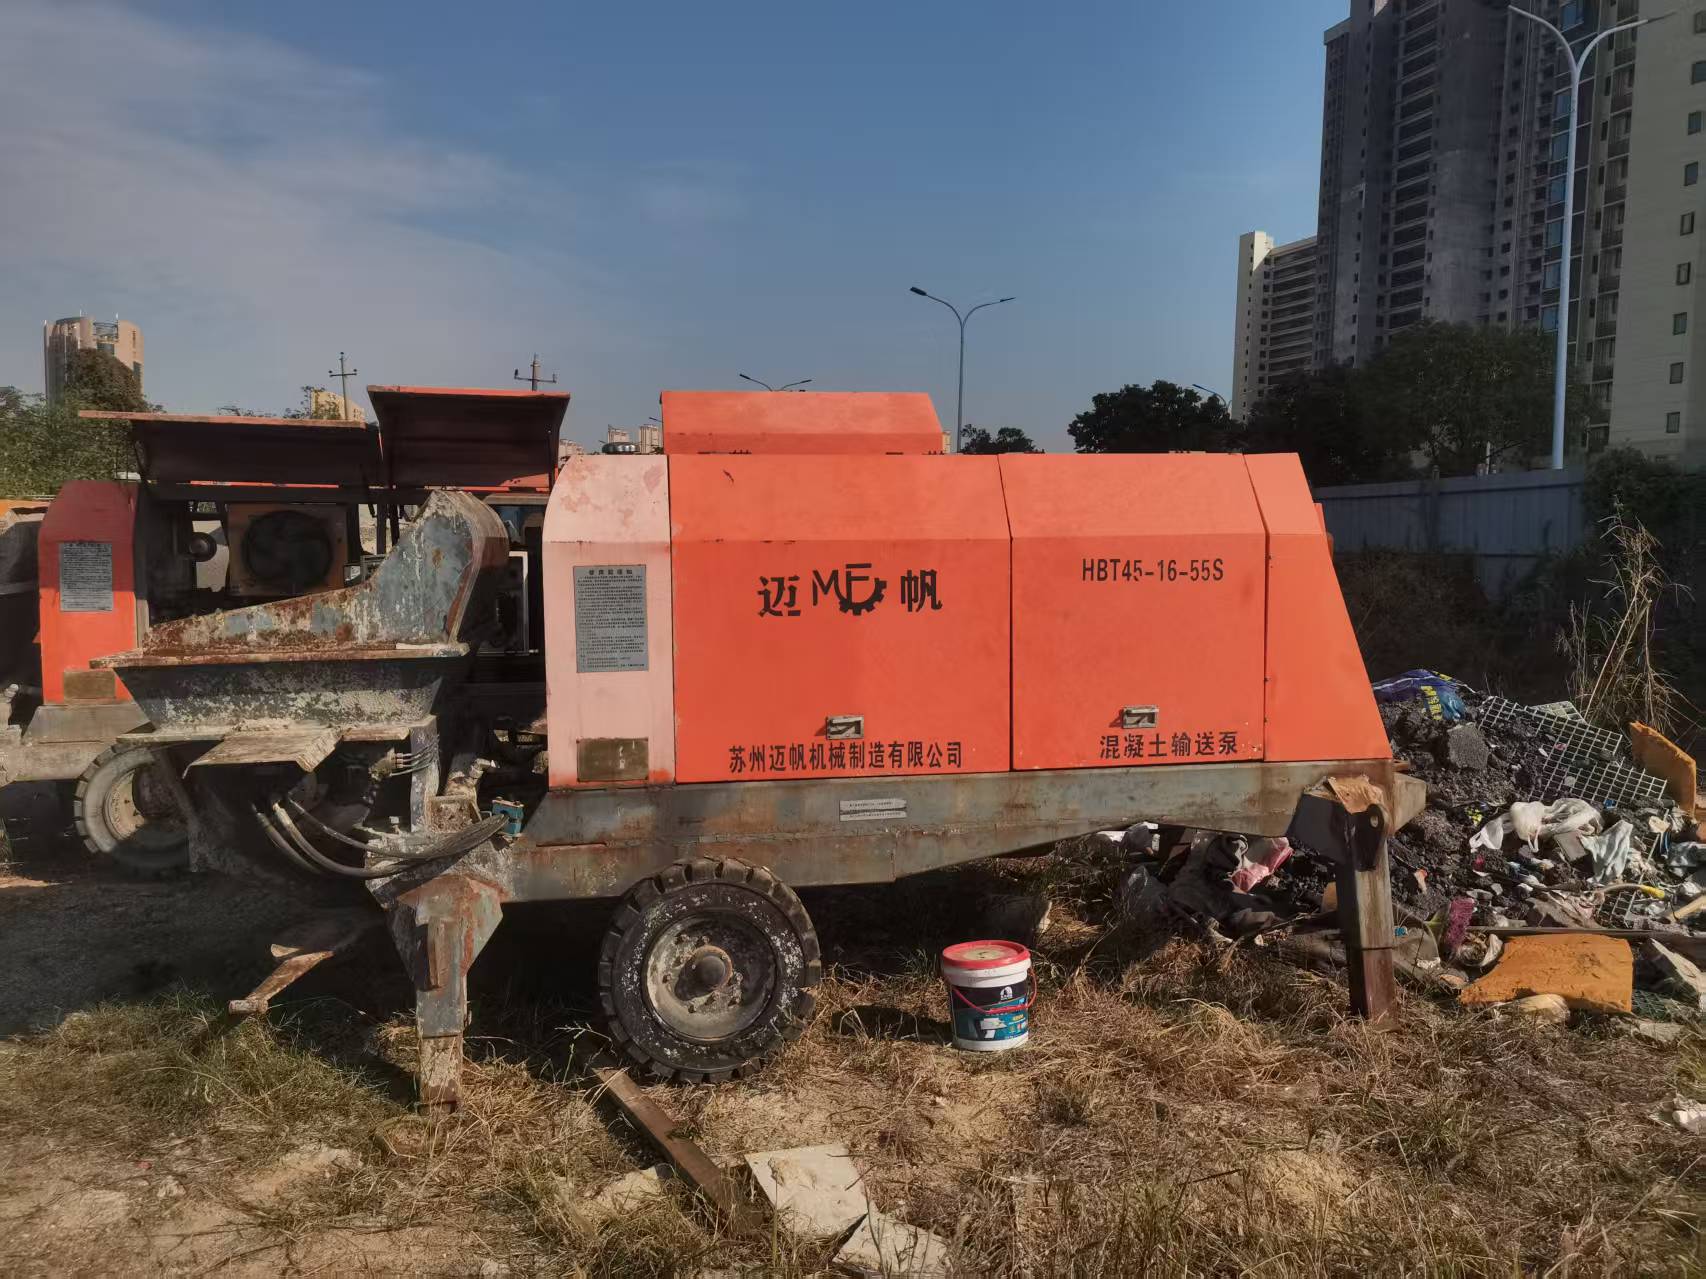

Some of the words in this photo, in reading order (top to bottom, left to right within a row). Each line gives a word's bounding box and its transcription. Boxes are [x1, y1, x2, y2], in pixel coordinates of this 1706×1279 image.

[1082, 558, 1225, 582] HBT45-16-55S
[756, 575, 802, 617] 迈
[900, 569, 943, 613] 帆
[728, 741, 963, 773] 苏州迈帆机械制造有限公司
[1099, 731, 1239, 760] 混凝土输送泵
